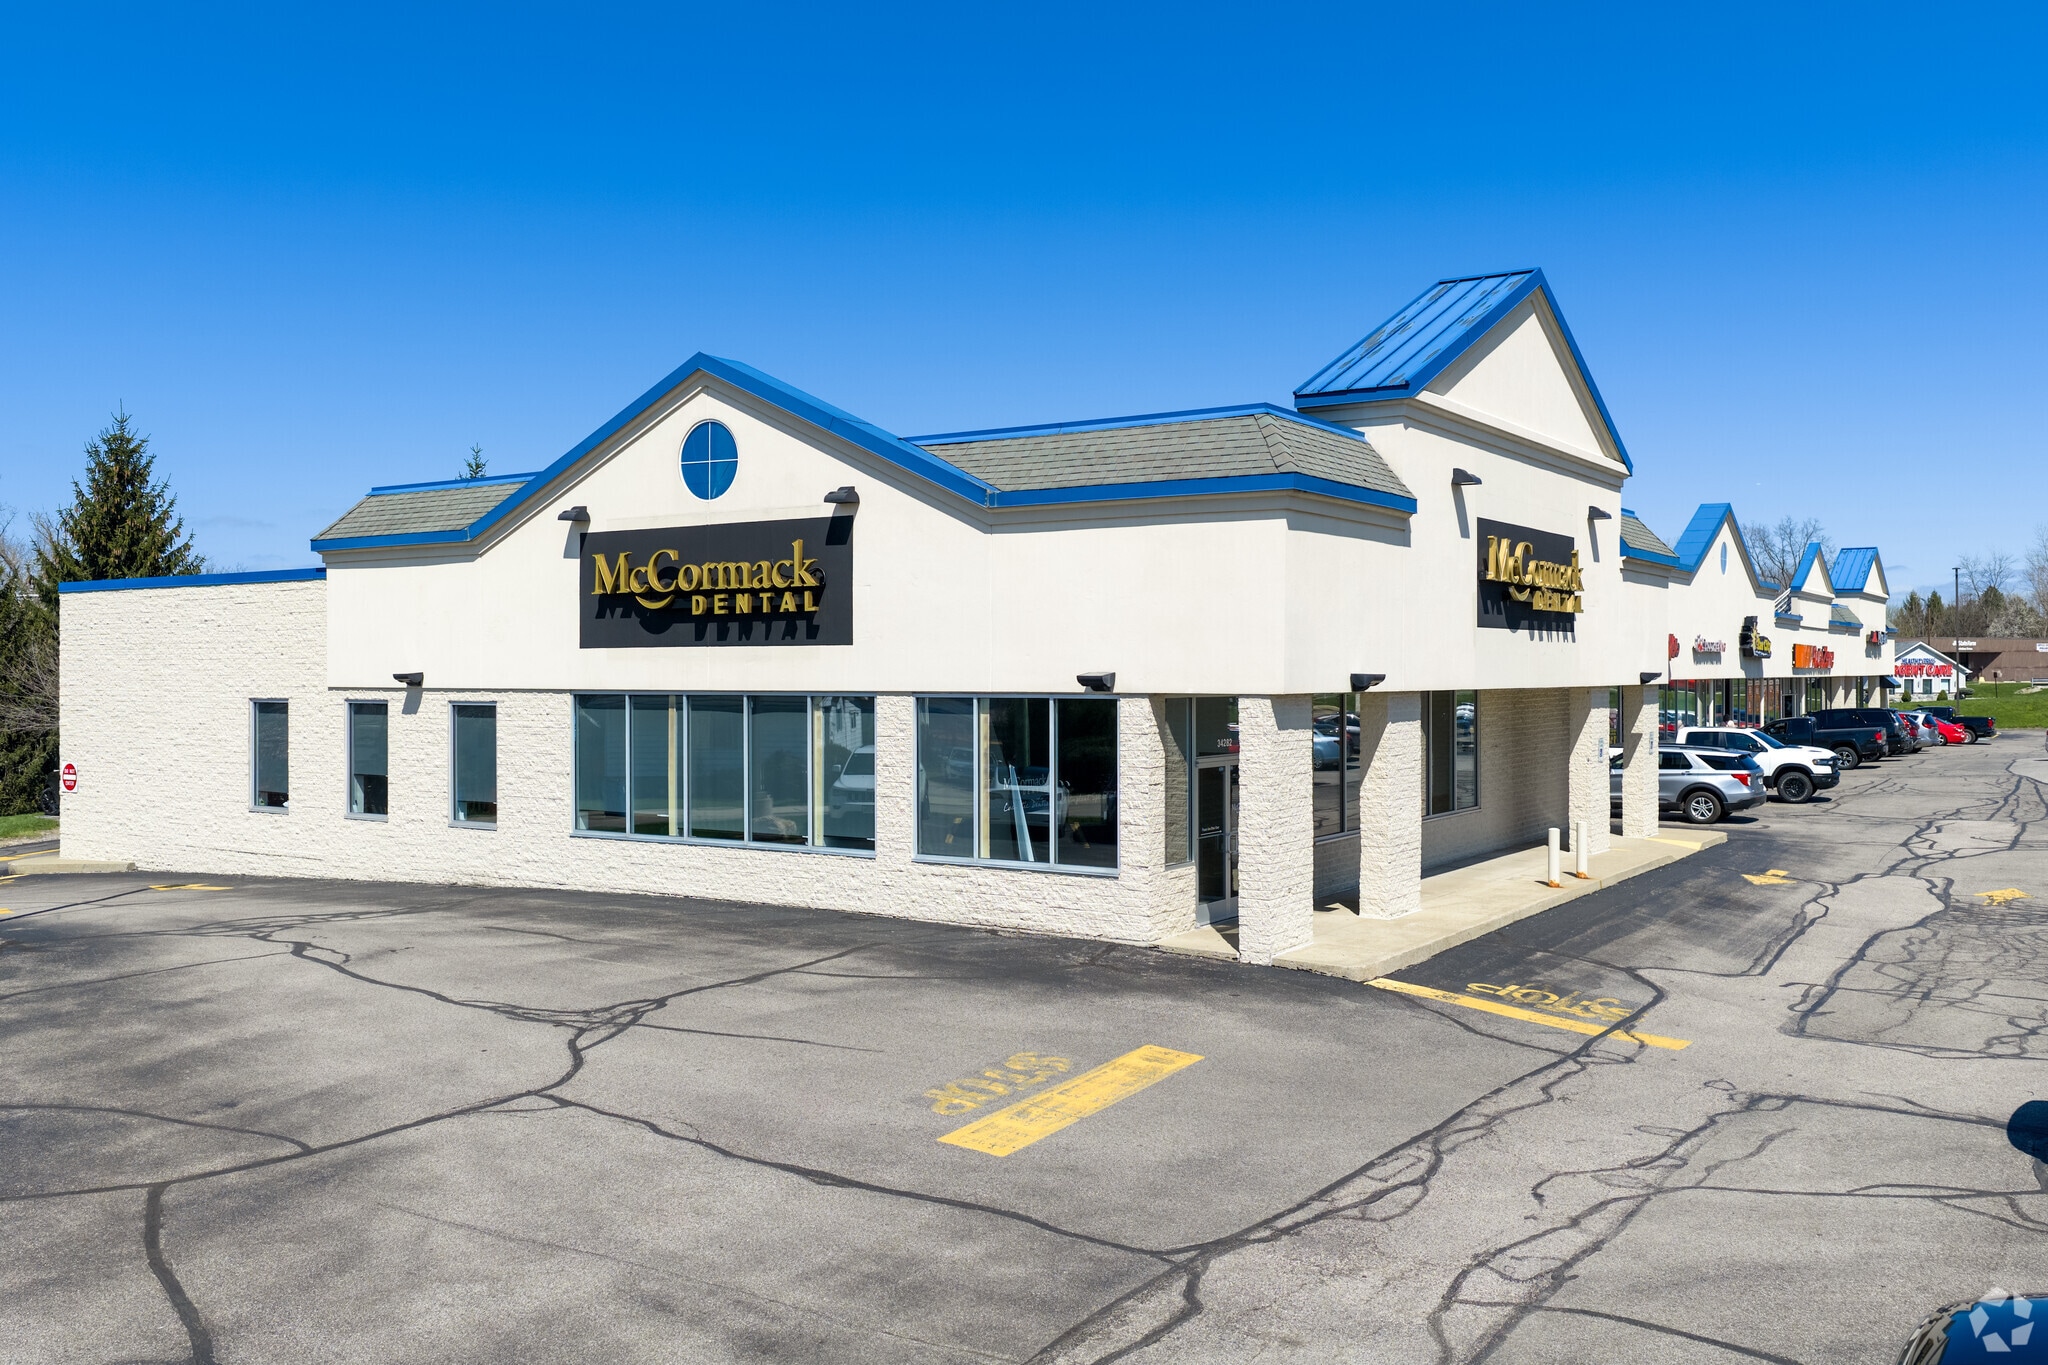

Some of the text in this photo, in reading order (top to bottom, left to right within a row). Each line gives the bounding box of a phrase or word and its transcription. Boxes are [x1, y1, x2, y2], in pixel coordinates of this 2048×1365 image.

[591, 539, 820, 595] McCormack
[1486, 535, 1584, 591] McCormack
[691, 590, 819, 615] DENTAL
[1894, 664, 1953, 677] RGENT CARE
